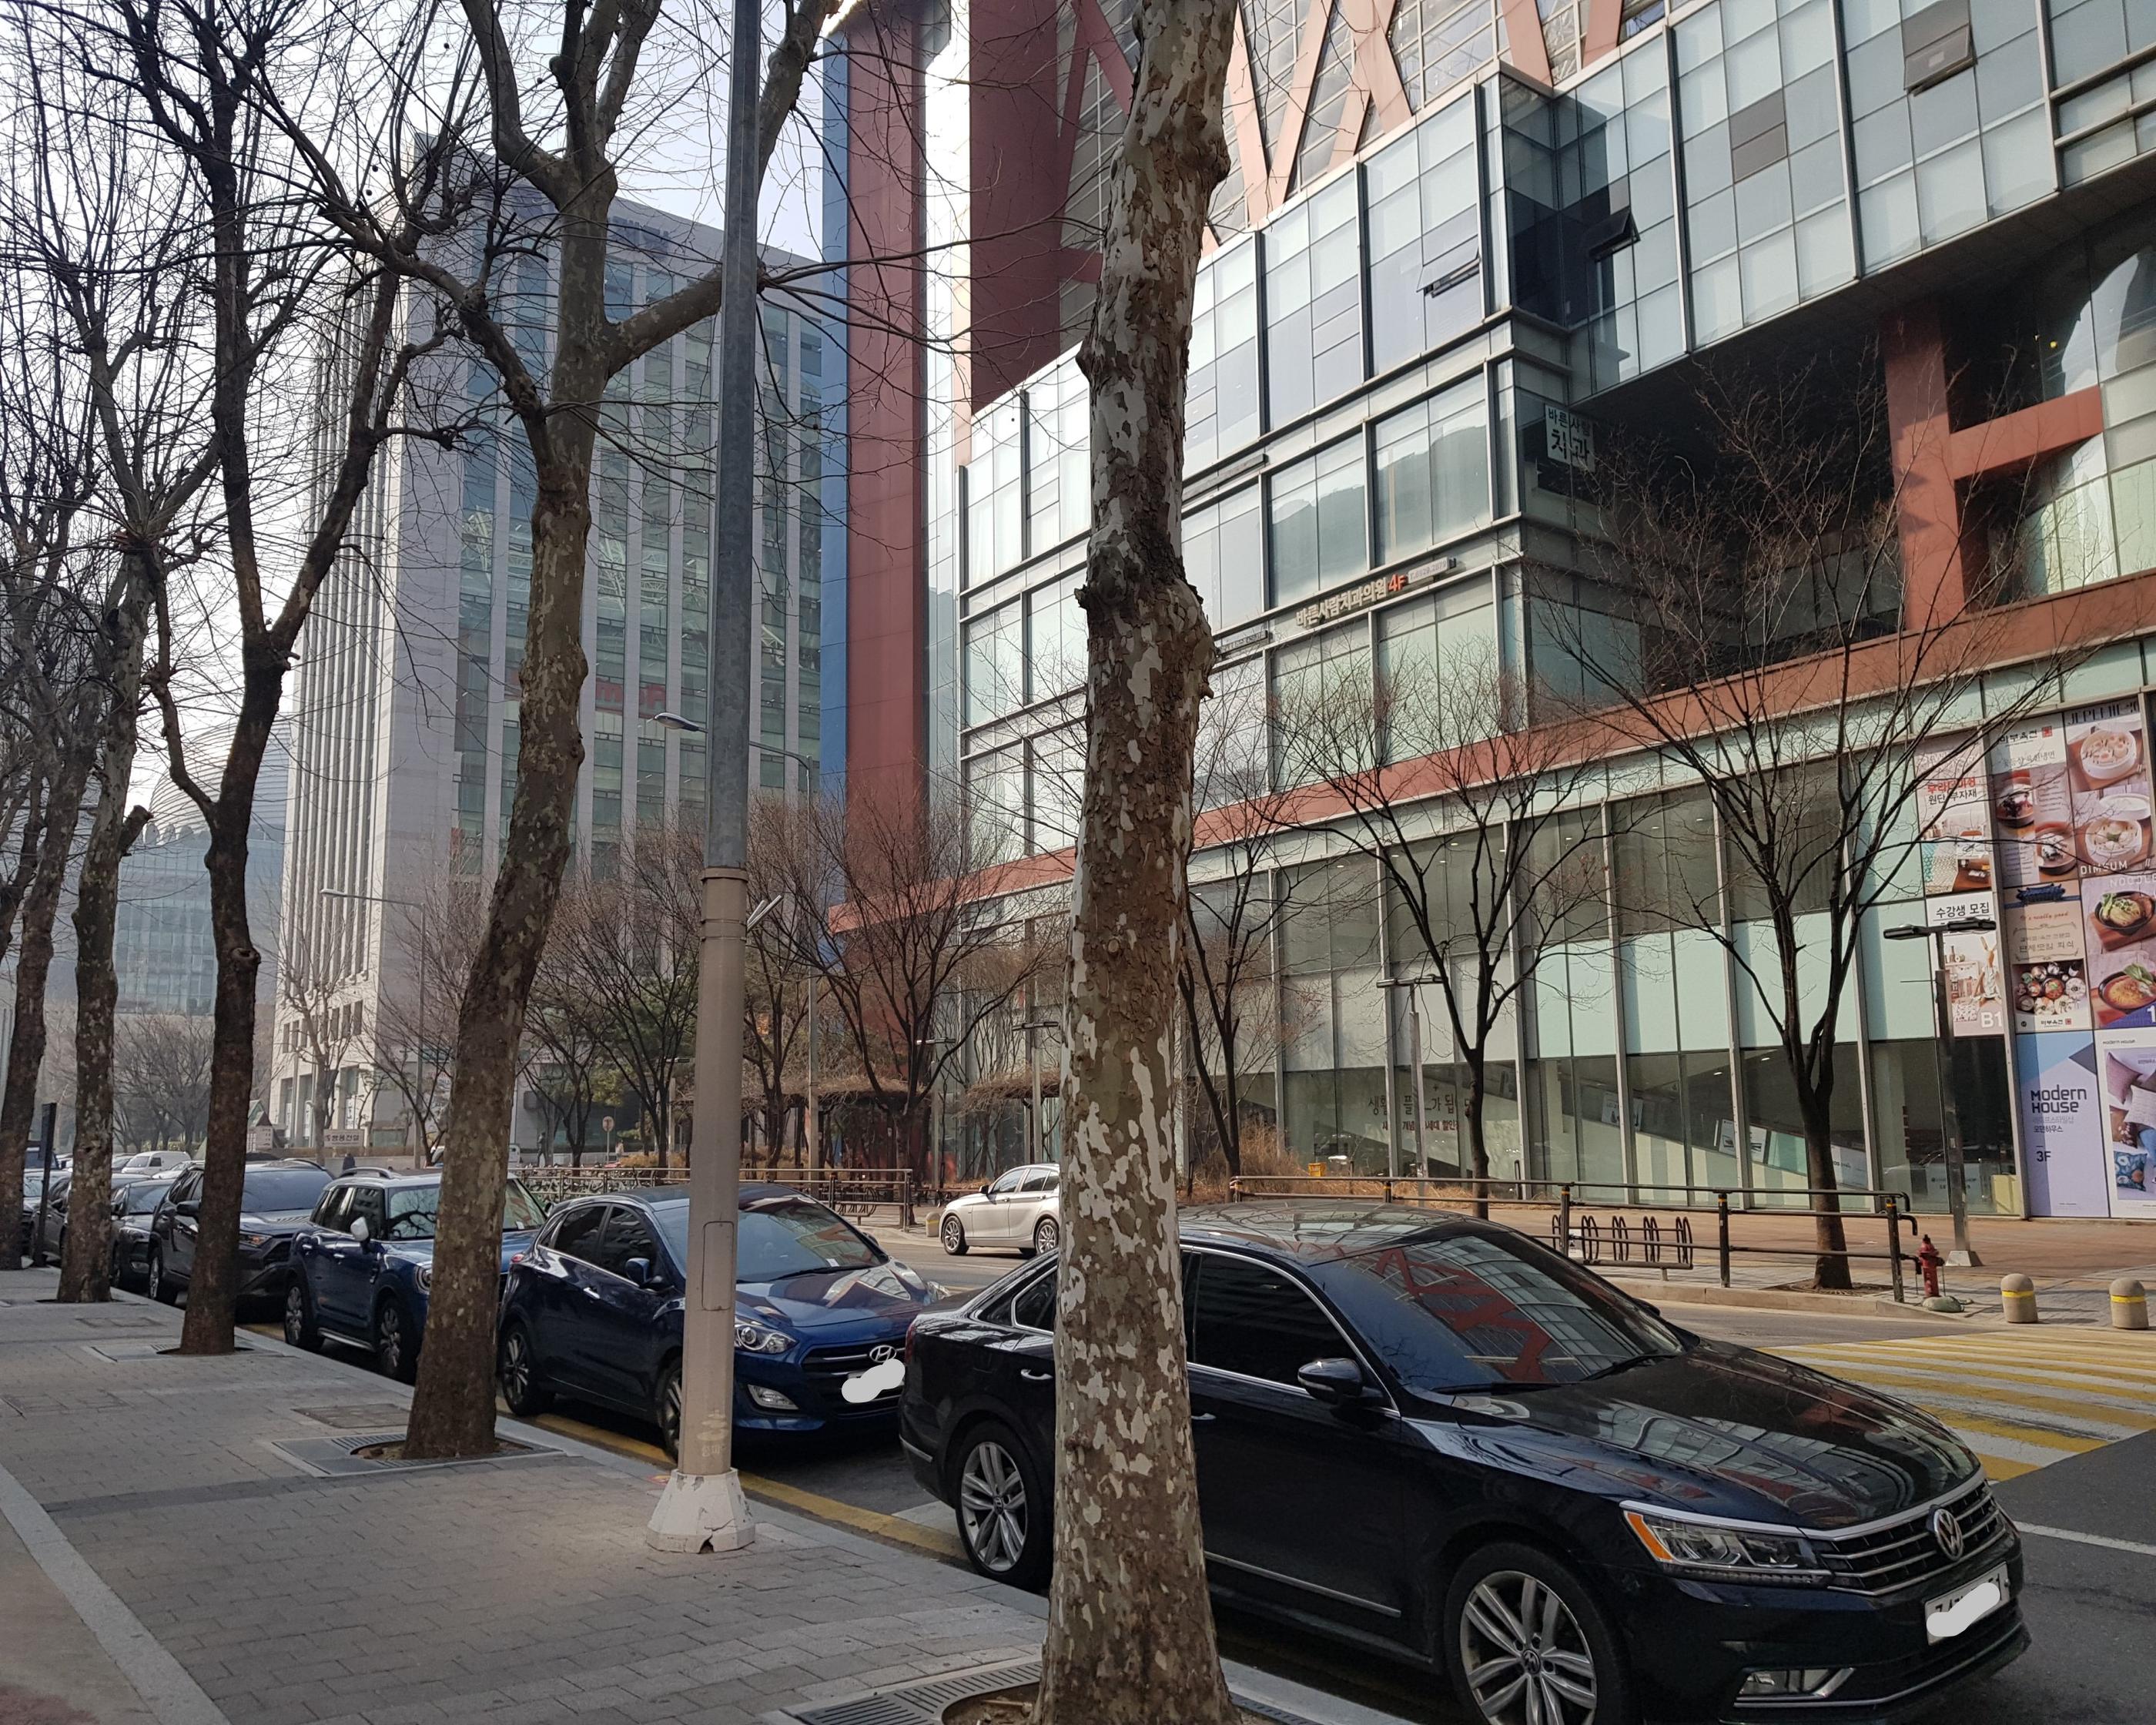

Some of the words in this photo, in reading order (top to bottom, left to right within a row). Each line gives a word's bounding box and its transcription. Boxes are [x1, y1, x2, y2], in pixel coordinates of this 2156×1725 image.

[1552, 428, 1590, 462] 치과
[1296, 578, 1387, 627] 바른사람치과의원
[1388, 574, 1406, 591] 4F
[2081, 860, 2128, 875] DIMSUM
[1936, 905, 1966, 919] 수강생
[1970, 902, 1990, 914] 모집
[1980, 1010, 2003, 1028] B1
[2030, 1084, 2087, 1101] Modern
[2031, 1101, 2079, 1114] House
[2034, 1125, 2064, 1134] 모던하우스
[2036, 1151, 2051, 1162] 3F
